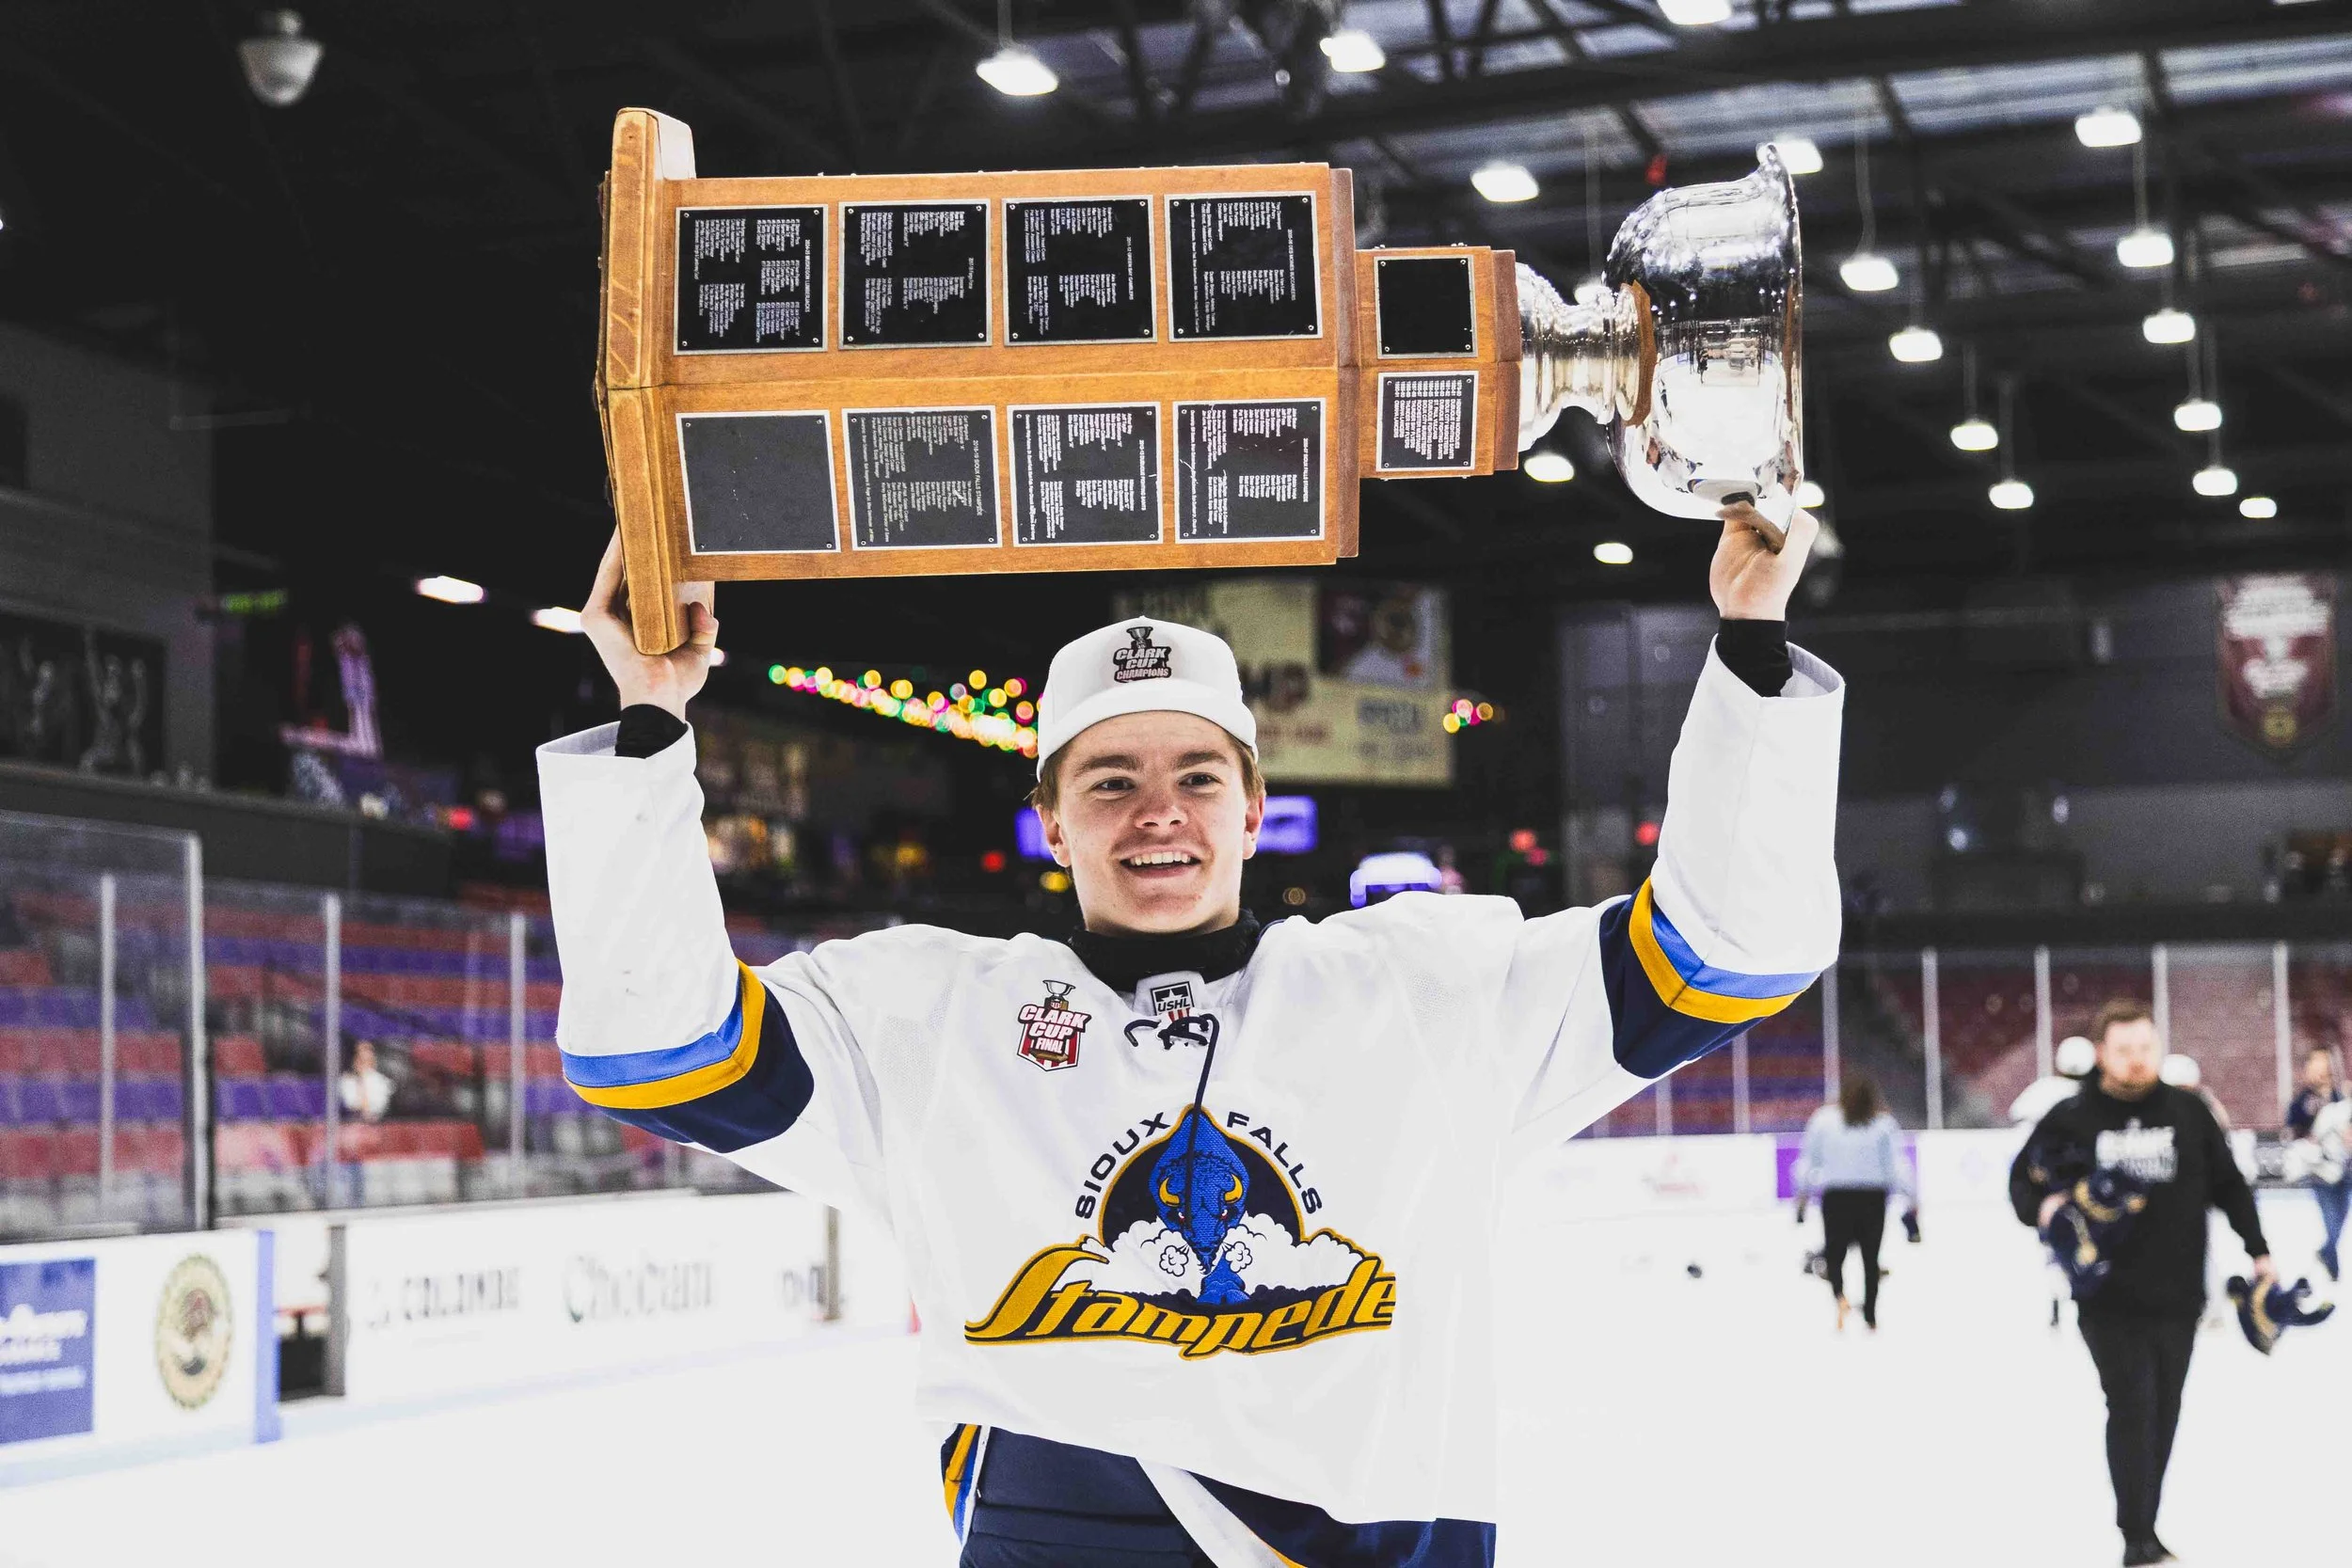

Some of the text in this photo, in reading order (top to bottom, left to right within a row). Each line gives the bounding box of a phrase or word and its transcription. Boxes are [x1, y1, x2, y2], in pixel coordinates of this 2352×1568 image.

[1115, 647, 1168, 660] CLARK
[1125, 657, 1158, 669] CUP
[1116, 668, 1169, 680] CHAMPIONS
[1157, 997, 1191, 1012] USHL
[1019, 1005, 1089, 1029] CLARK
[1028, 1022, 1074, 1039] CUP
[1036, 1037, 1064, 1053] FINAL
[1074, 1111, 1323, 1220] SIOUX FALLS
[964, 1243, 1396, 1360] Stampede
